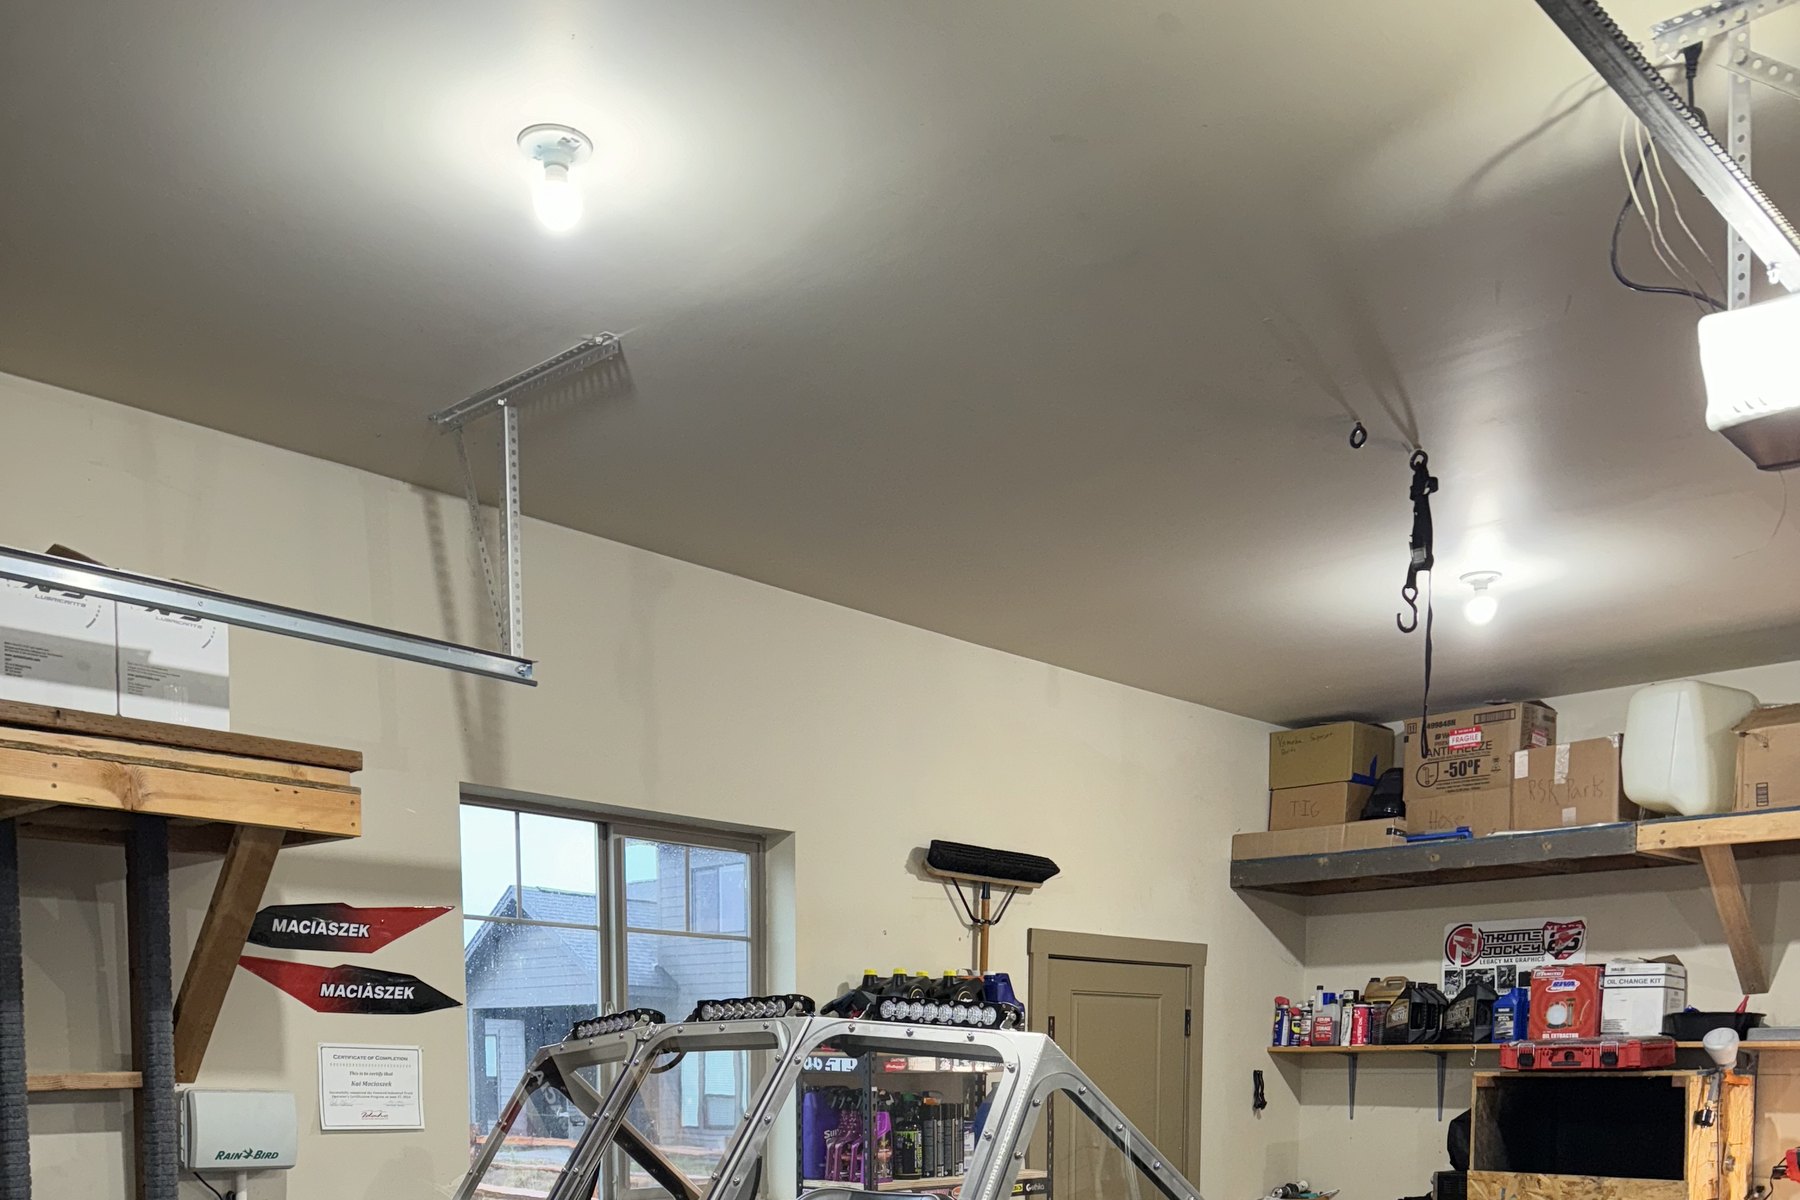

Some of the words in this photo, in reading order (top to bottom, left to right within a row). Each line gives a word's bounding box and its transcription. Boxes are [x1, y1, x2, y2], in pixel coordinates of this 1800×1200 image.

[1451, 733, 1480, 745] FRAGILE
[271, 918, 371, 938] MACIASZEK
[1484, 931, 1543, 944] THROTTLE
[1482, 943, 1544, 956] JOCKEY
[320, 983, 416, 1000] MACIASZEK
[214, 1150, 243, 1160] RAIN
[253, 1149, 279, 1159] BIRD
